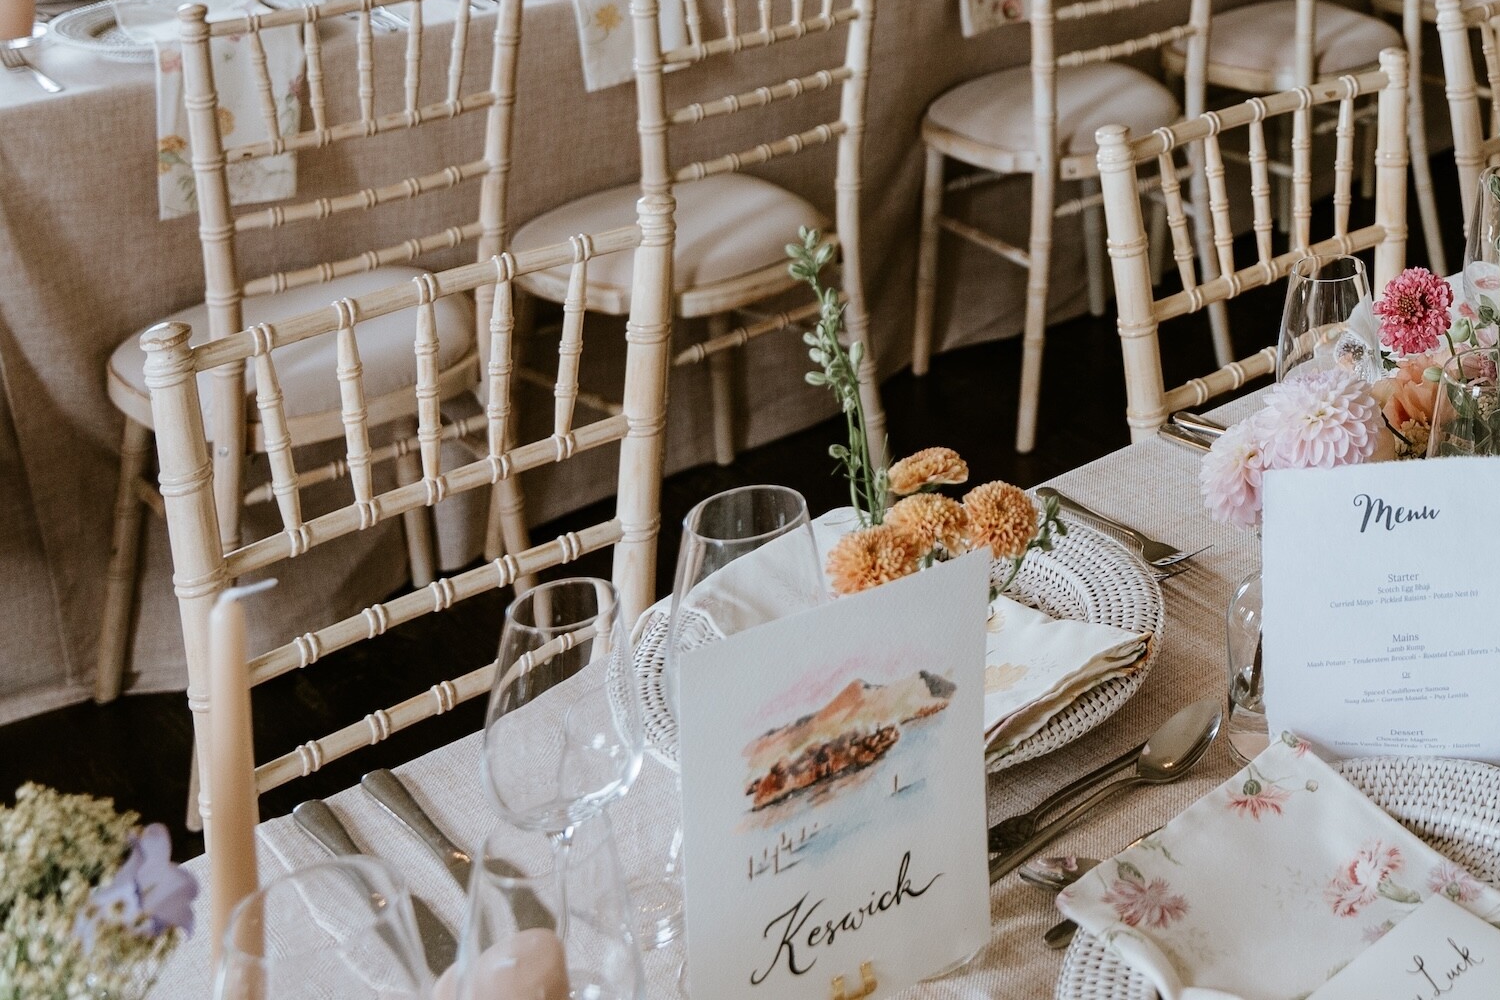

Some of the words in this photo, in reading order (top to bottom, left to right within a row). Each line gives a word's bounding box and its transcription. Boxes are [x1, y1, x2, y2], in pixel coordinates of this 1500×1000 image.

[1353, 493, 1440, 533] Menu
[1387, 573, 1420, 583] Starter
[1377, 585, 1400, 594] Scotch
[1401, 585, 1414, 594] Egg
[1329, 599, 1355, 608] Curried
[1356, 598, 1374, 607] Mayo
[1380, 595, 1402, 604] Pickled
[1433, 592, 1453, 600] Potato
[1392, 632, 1420, 643] Mains
[1386, 645, 1405, 653] Lamb
[1406, 644, 1426, 652] Rump
[1352, 656, 1390, 665] Tenderstem
[1391, 653, 1417, 662] Broccoli
[1449, 649, 1466, 658] Cauli
[1466, 648, 1489, 656] Florets
[1401, 671, 1412, 679] Or
[1362, 689, 1386, 697] Spiced
[1390, 728, 1424, 736] Dessert
[750, 851, 945, 985] Keswick
